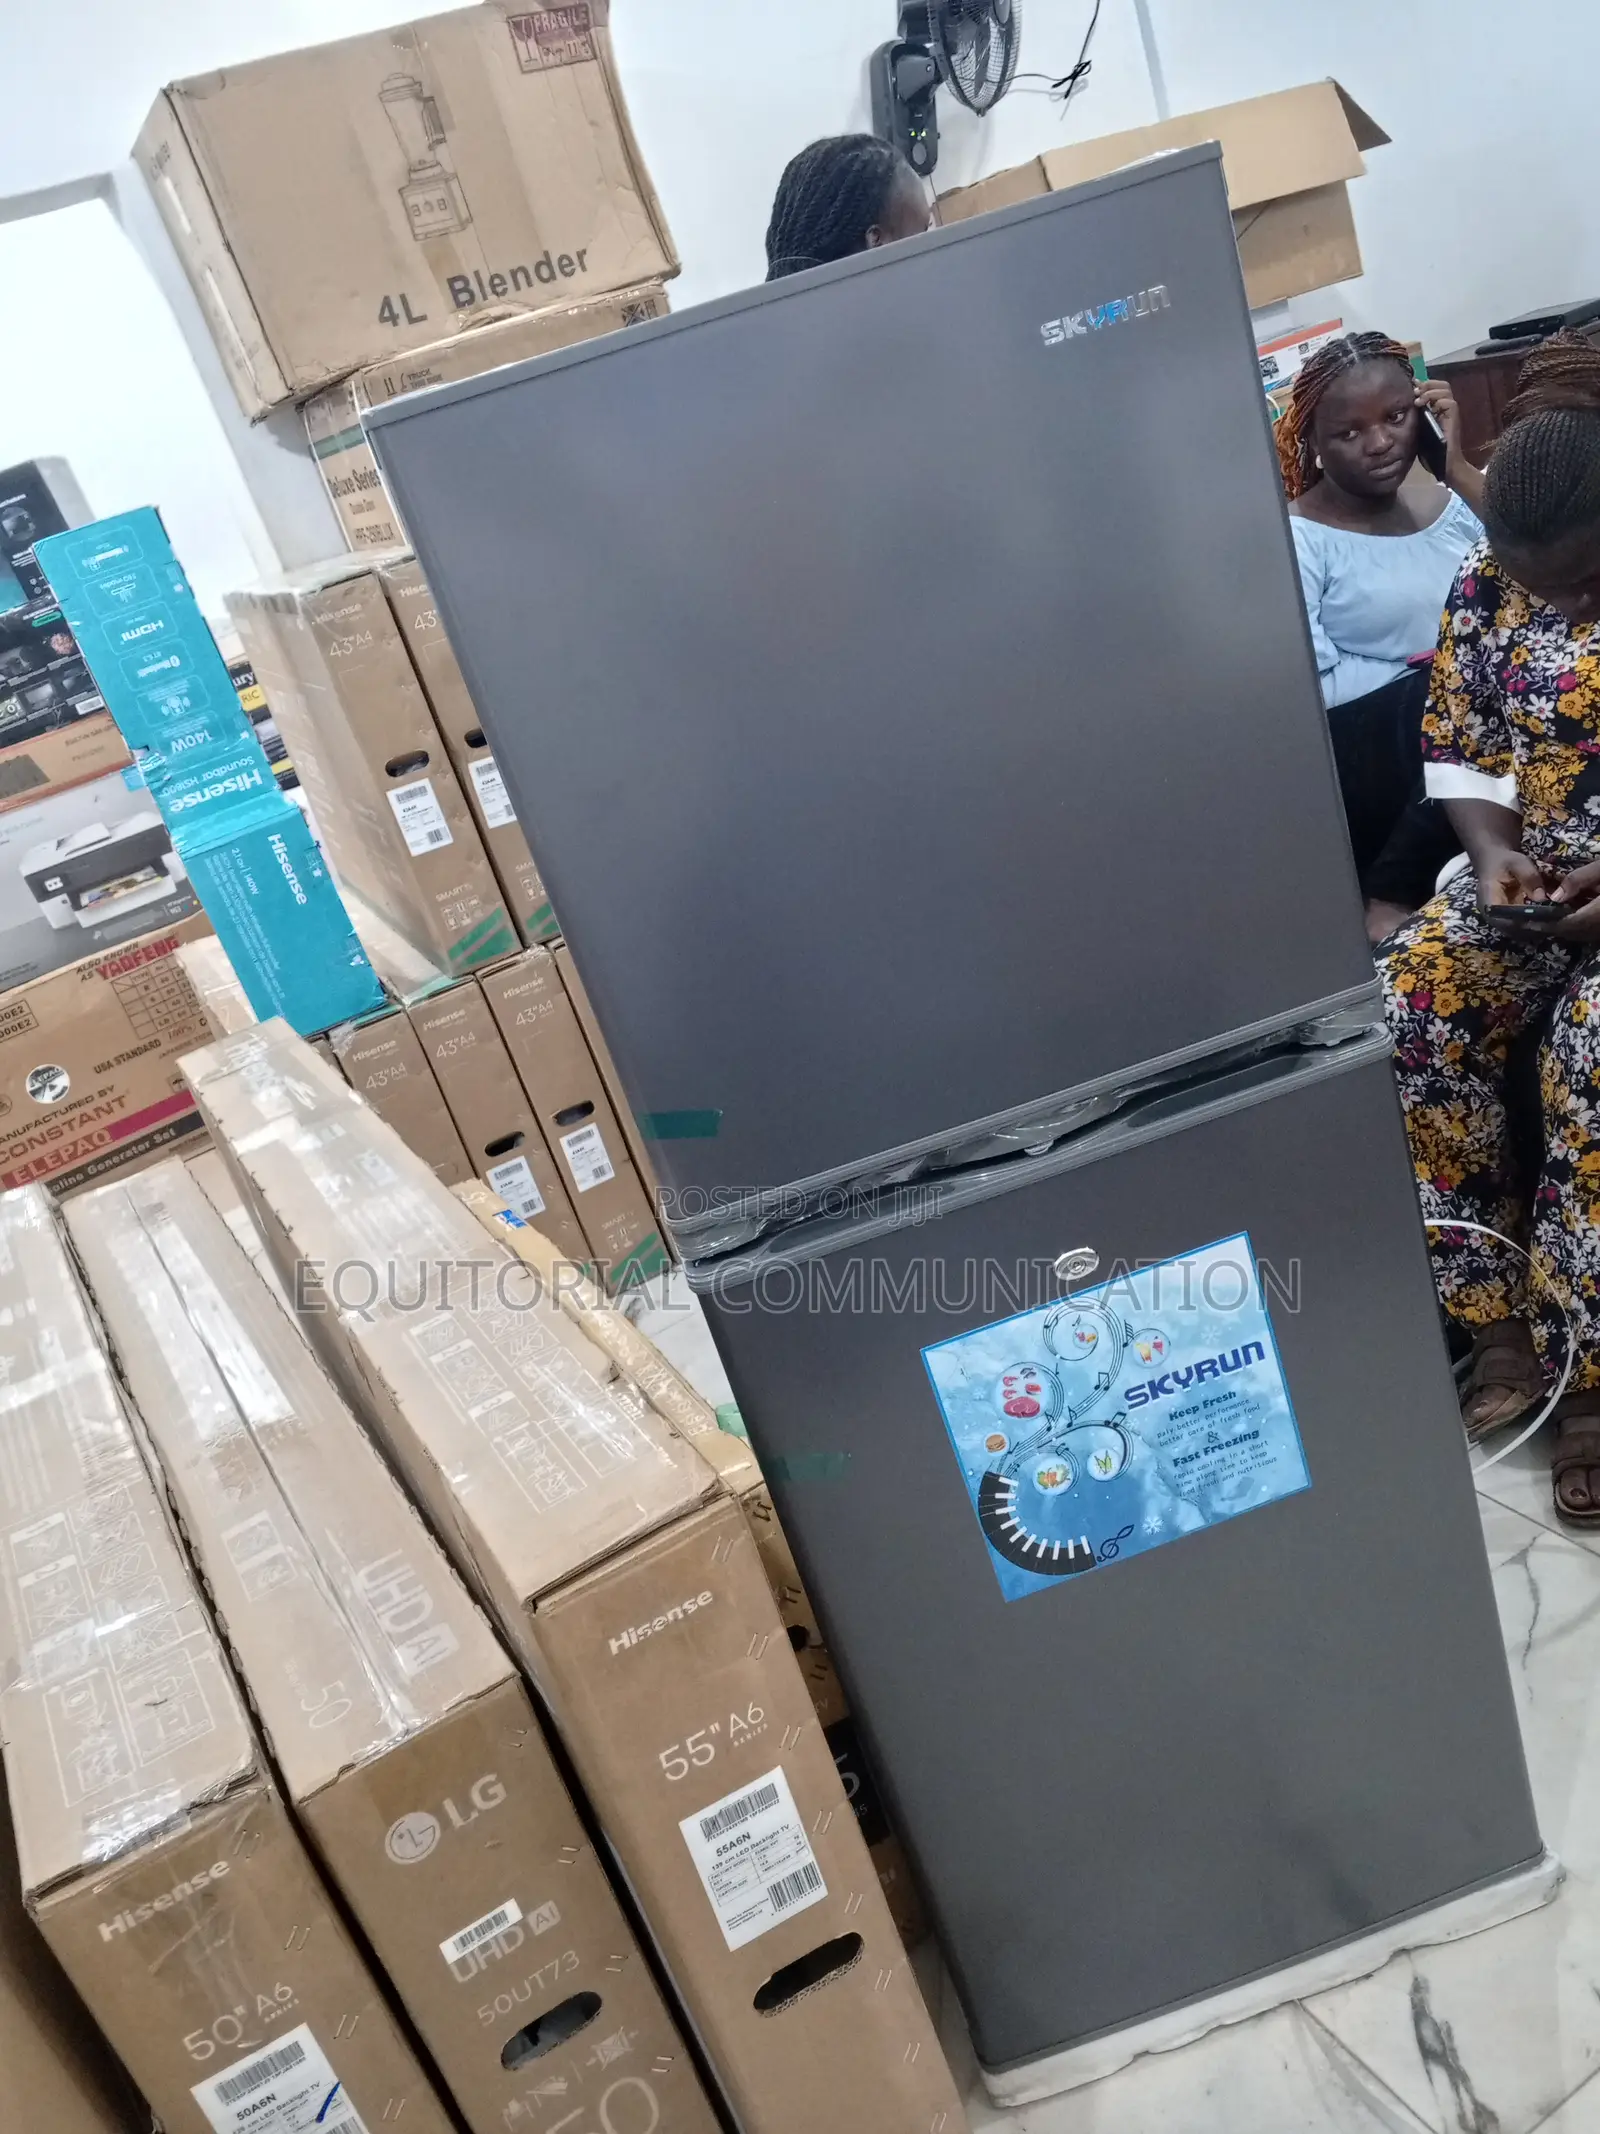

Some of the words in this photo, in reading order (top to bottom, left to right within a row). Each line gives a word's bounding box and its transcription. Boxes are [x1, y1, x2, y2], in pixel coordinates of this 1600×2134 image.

[533, 5, 588, 33] FRAGILE
[378, 293, 428, 328] 4L
[446, 248, 588, 309] Blender
[1040, 284, 1171, 346] SKYRUN
[202, 755, 255, 781] Soundbar
[169, 768, 263, 812] Hisense
[267, 833, 308, 905] Hisense
[503, 976, 545, 999] Hisense
[422, 1008, 466, 1031] Hisense
[94, 1063, 114, 1075] USA
[114, 1038, 162, 1066] STANDARD
[353, 1038, 397, 1062] Hisense
[97, 1084, 115, 1097] BY
[12, 1128, 113, 1185] ELEPAQ
[87, 1141, 150, 1176] Generator
[153, 1127, 176, 1145] Set
[1124, 1341, 1265, 1410] SKYRUN
[1168, 1405, 1200, 1421] Keep
[1202, 1391, 1236, 1409] Fresh
[1243, 1403, 1260, 1415] food
[1172, 1451, 1201, 1467] Fast
[1203, 1429, 1260, 1457] Freezing
[1207, 1430, 1220, 1444] &
[356, 1549, 435, 1635] UHD
[608, 1589, 713, 1656] Hisense
[659, 1721, 721, 1781] 55"
[729, 1701, 765, 1739] A6
[442, 1773, 507, 1830] LG
[715, 1831, 752, 1858] 55A6N
[724, 1855, 736, 1866] cm
[736, 1847, 750, 1860] LED
[750, 1829, 780, 1852] Backlight
[780, 1823, 790, 1834] TV
[97, 1859, 230, 1943] Hisense
[477, 1950, 581, 2027] 50UT73
[183, 2004, 246, 2061] 50"
[255, 1981, 293, 2017] A6
[236, 2092, 278, 2122] 50A6N
[259, 2107, 276, 2123] LED
[275, 2088, 310, 2112] Backlight
[309, 2081, 321, 2092] TV
